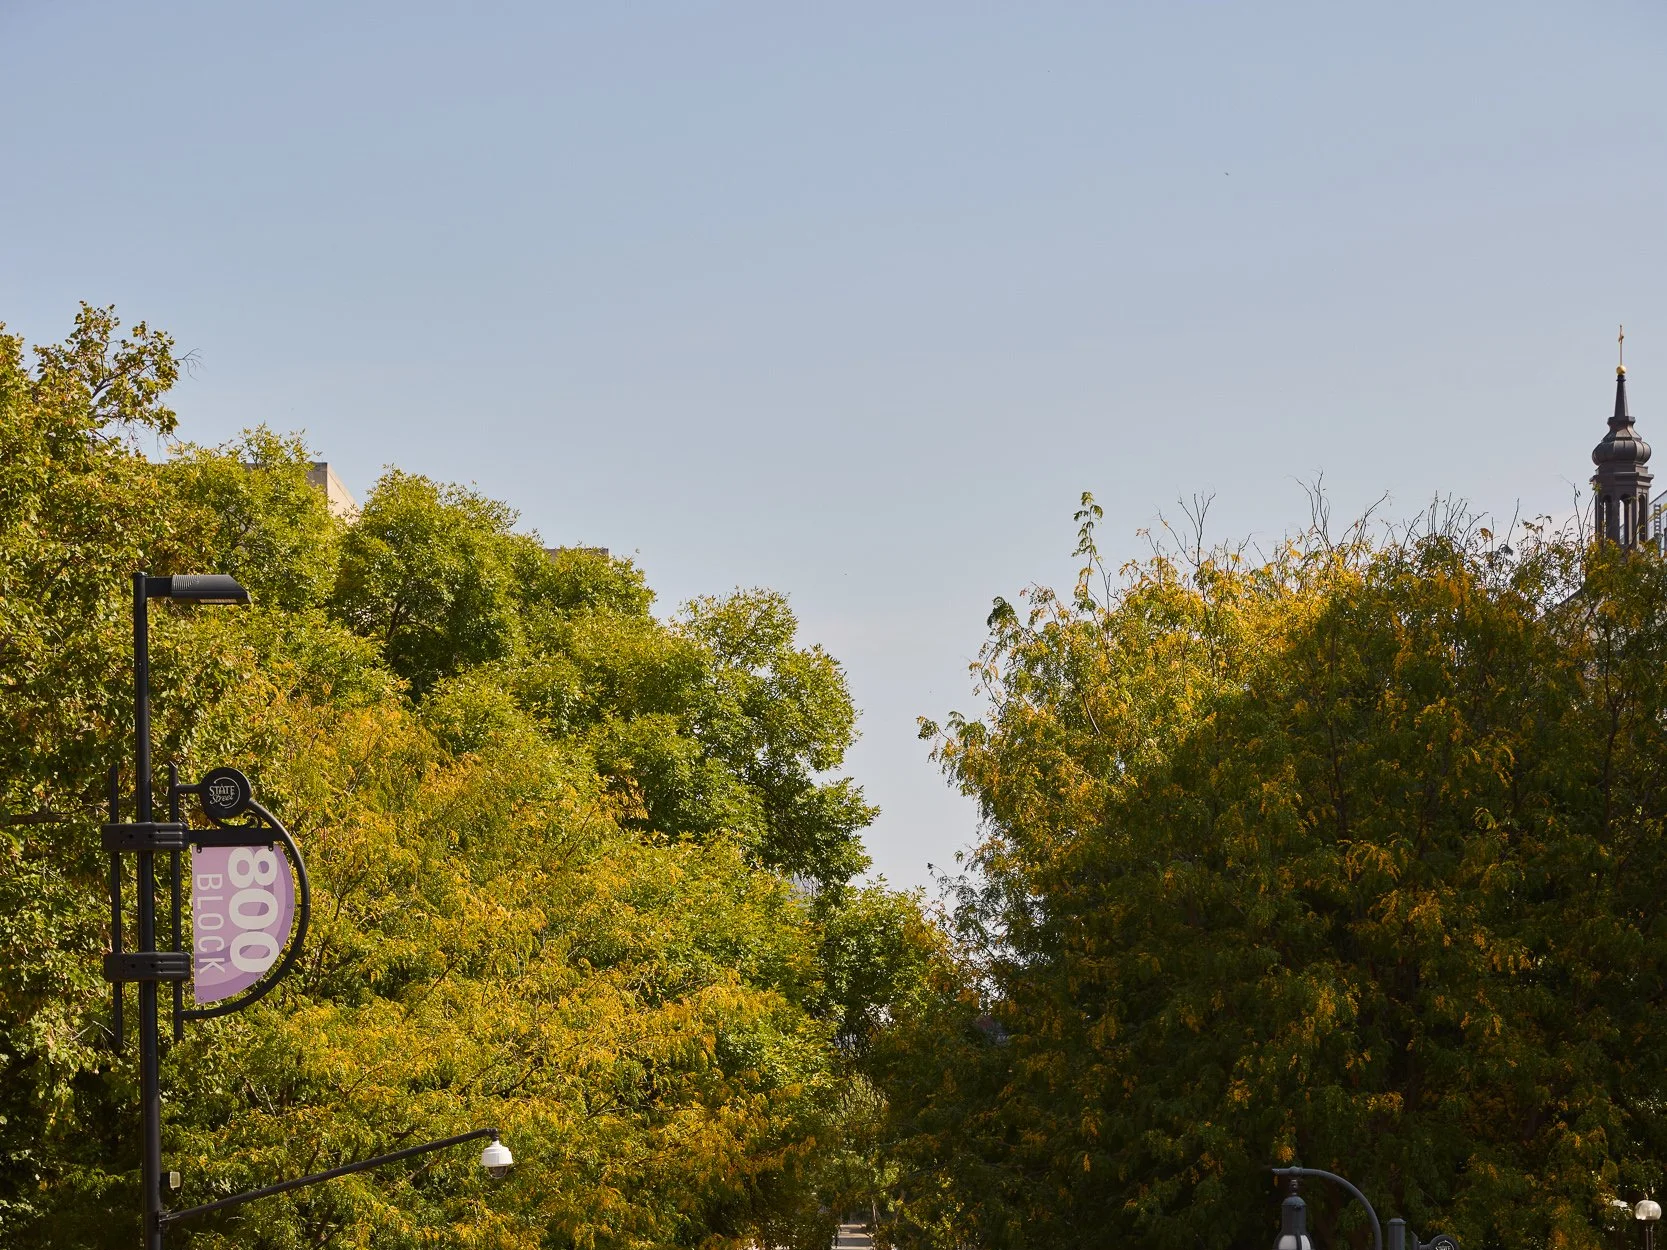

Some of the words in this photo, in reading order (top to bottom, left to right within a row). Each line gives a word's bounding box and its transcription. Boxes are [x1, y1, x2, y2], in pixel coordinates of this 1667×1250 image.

[209, 784, 235, 796] STATE
[196, 873, 226, 975] BLOCK
[227, 847, 280, 973] 800
